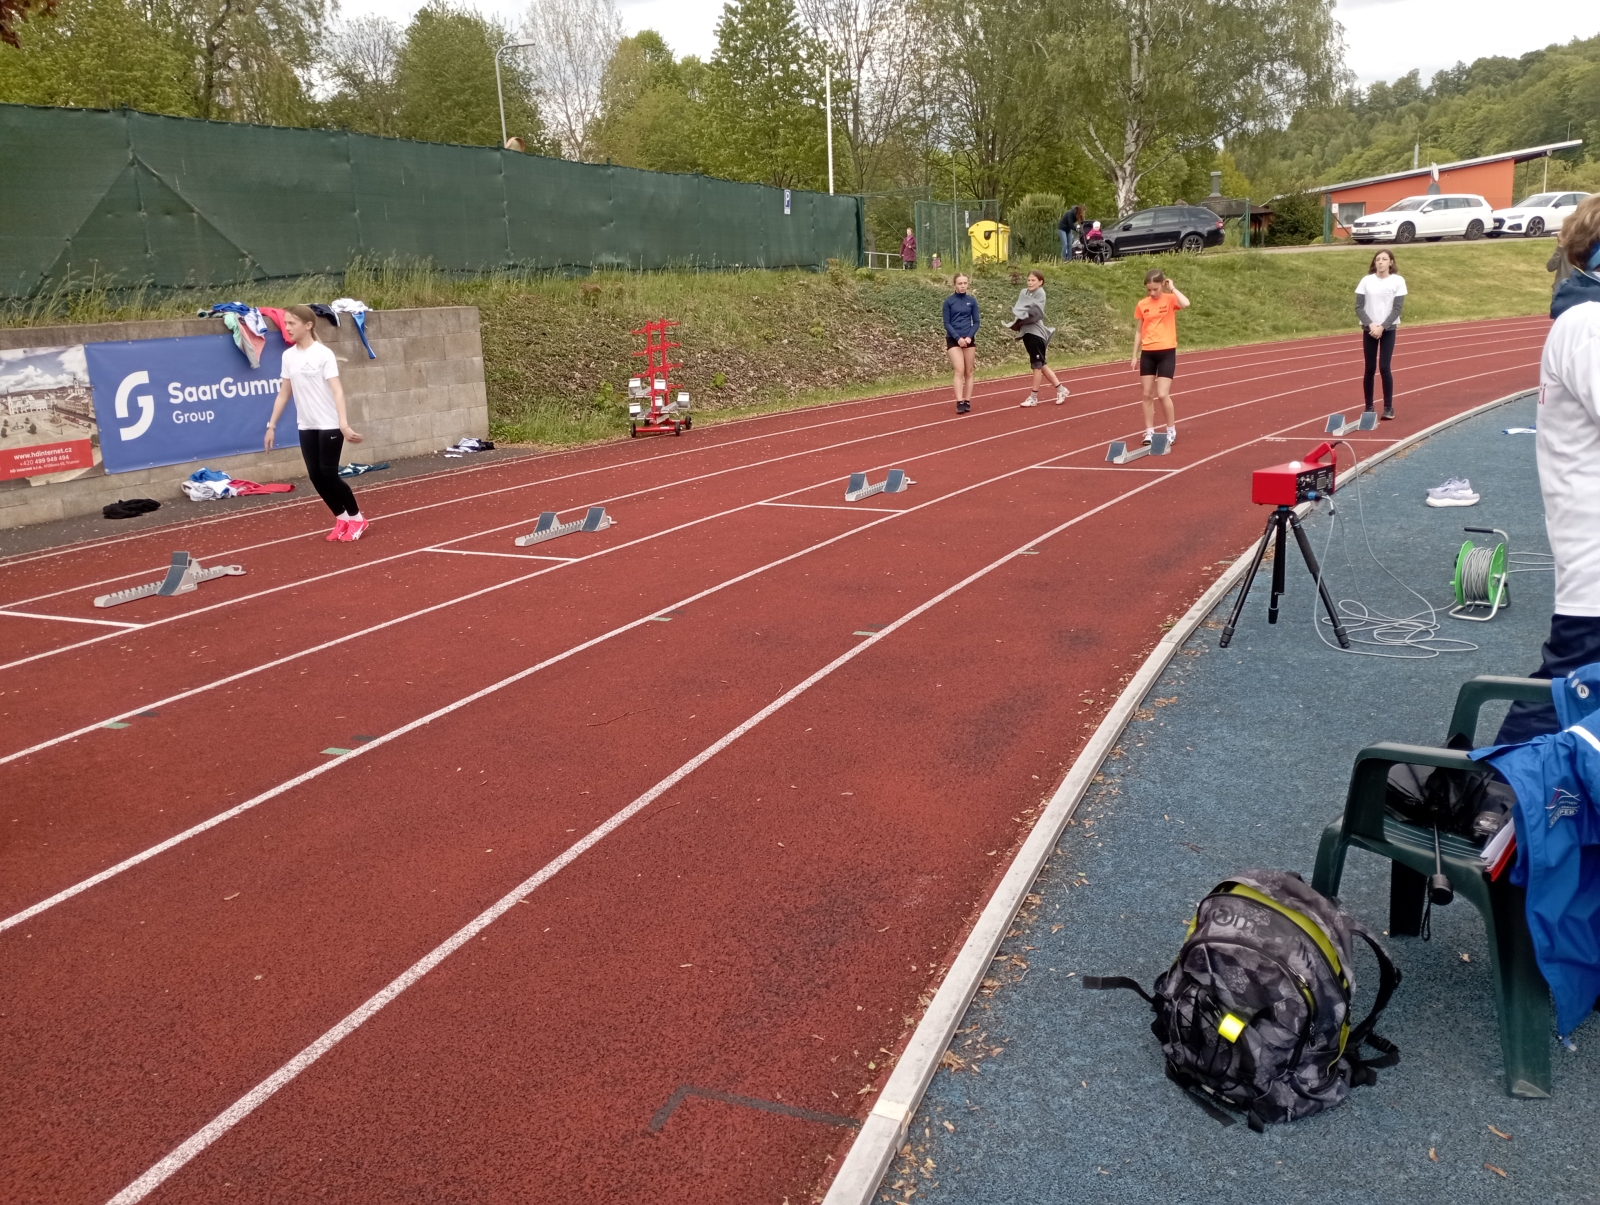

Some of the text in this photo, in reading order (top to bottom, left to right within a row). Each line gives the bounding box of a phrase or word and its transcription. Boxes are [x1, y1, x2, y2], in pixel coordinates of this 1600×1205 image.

[168, 377, 284, 404] SaarGumm
[172, 410, 215, 424] Group
[14, 447, 72, 460] www.hdinternet.cz
